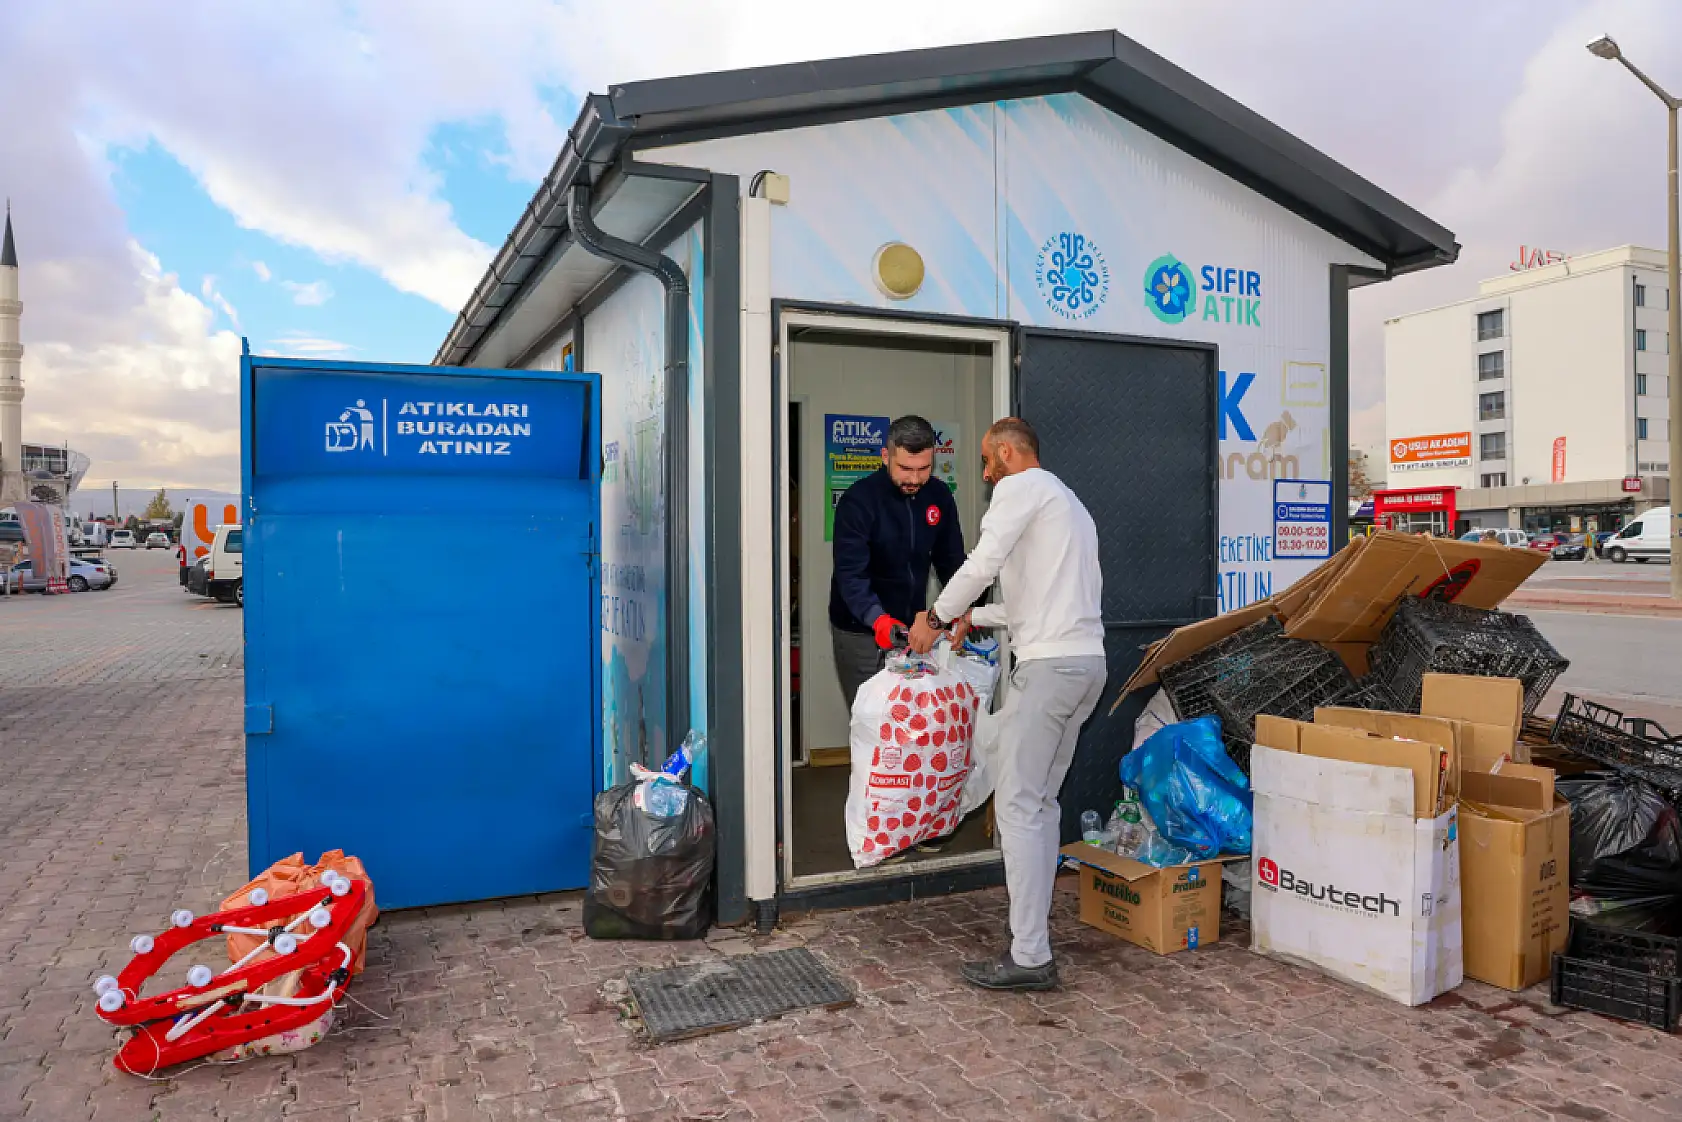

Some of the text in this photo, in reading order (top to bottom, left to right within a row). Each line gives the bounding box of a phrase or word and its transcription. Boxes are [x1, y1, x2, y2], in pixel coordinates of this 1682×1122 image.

[1200, 265, 1261, 296] SIFIR
[1203, 294, 1261, 327] ATIK
[399, 401, 528, 418] ATIKLARI
[1219, 371, 1257, 442] K
[397, 421, 531, 436] BURADAN
[833, 421, 872, 436] ATIK
[418, 441, 511, 456] ATINIZ
[1219, 532, 1272, 563] EKETİNE
[1217, 571, 1272, 613] ATILIN
[1280, 869, 1400, 917] Bautech
